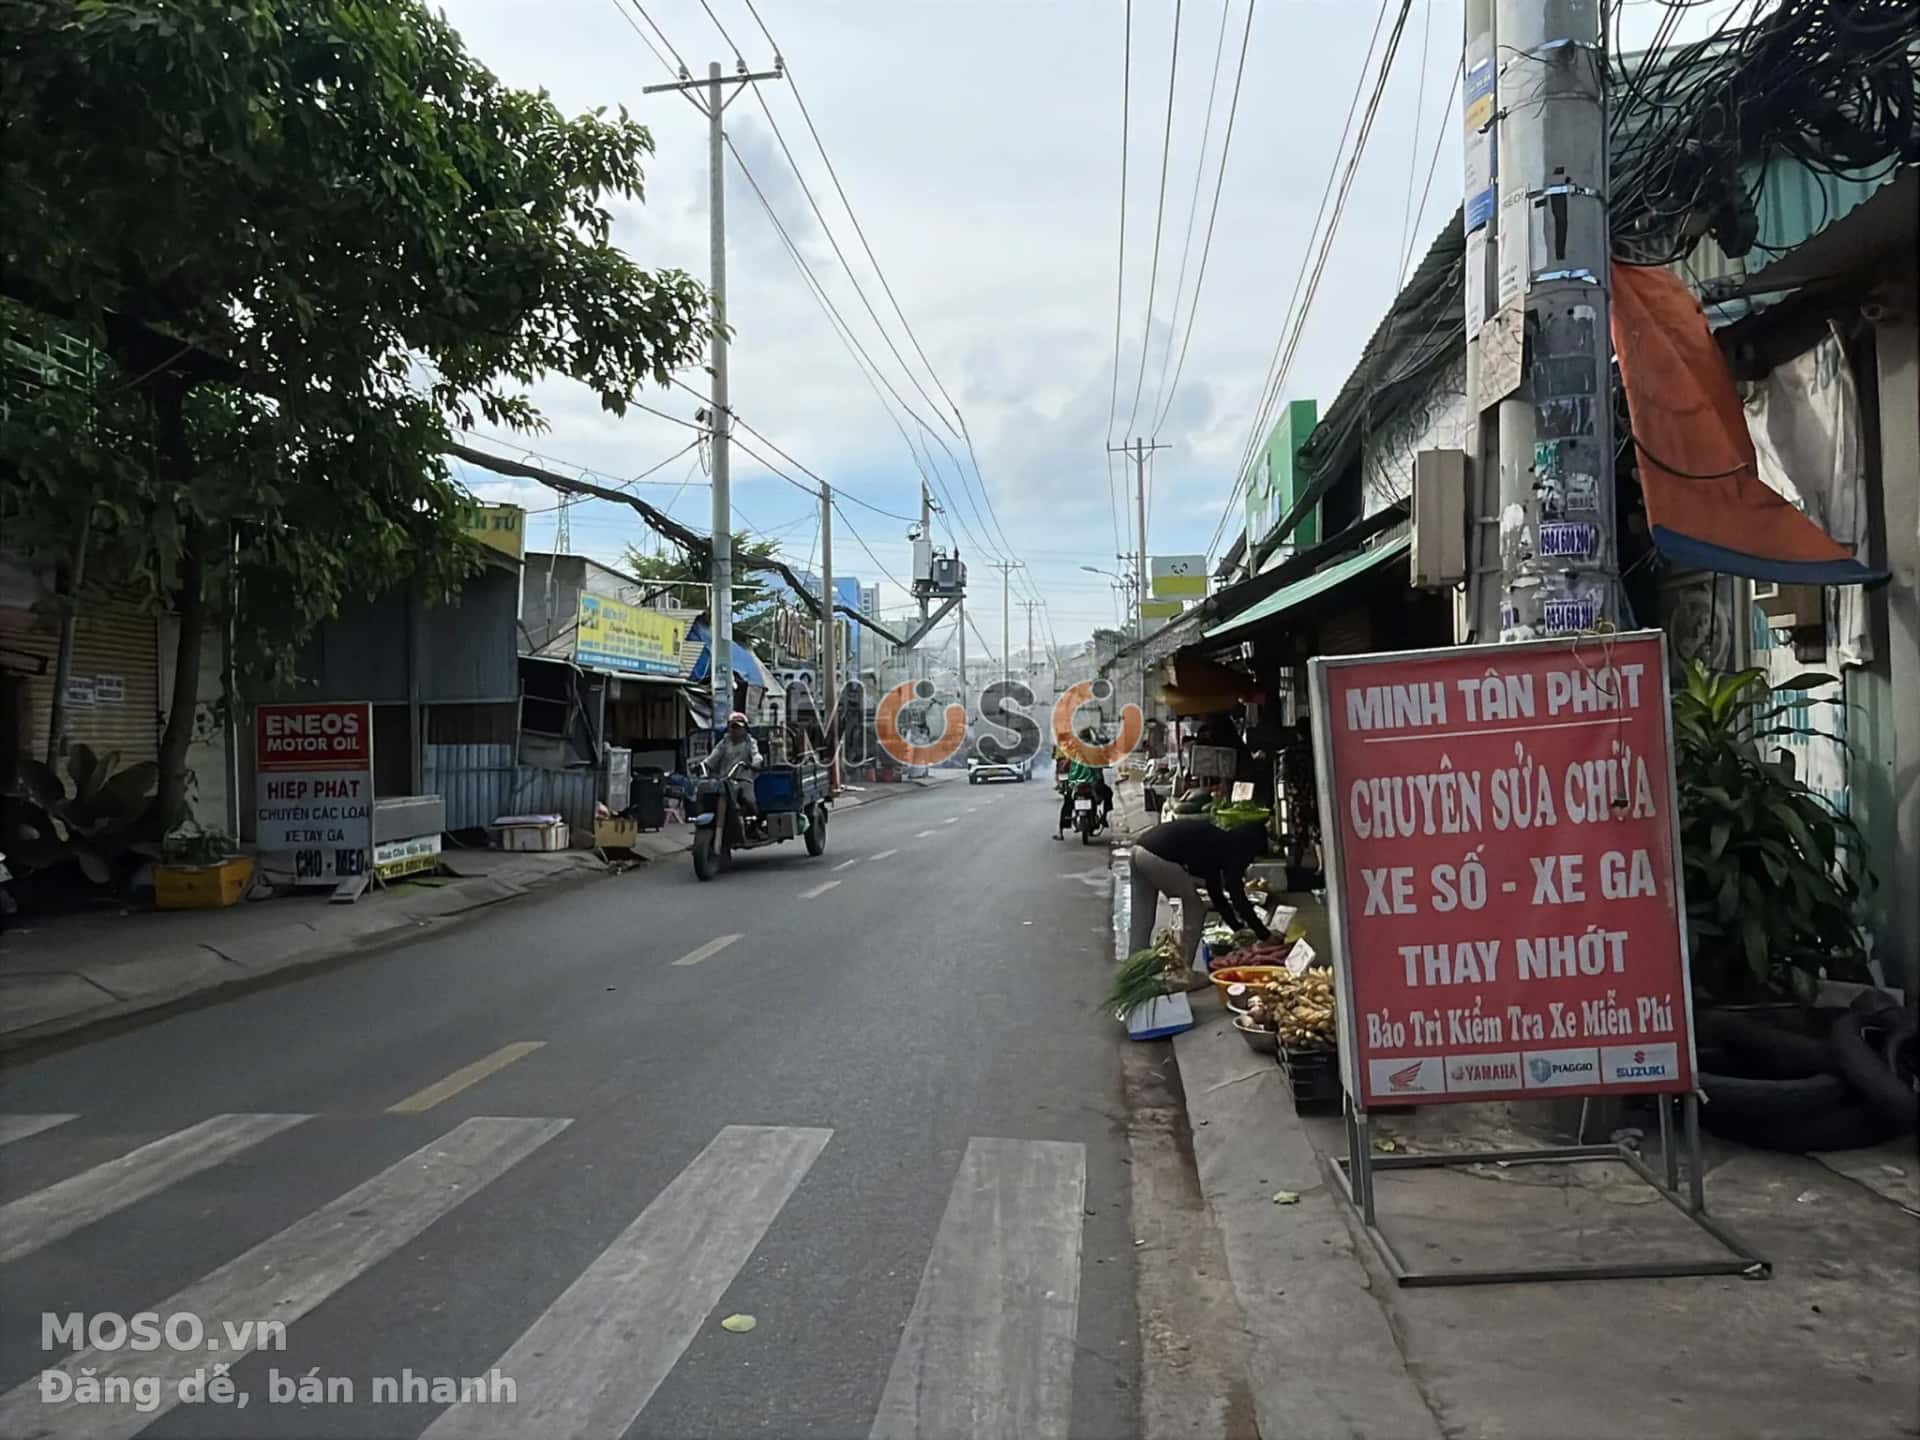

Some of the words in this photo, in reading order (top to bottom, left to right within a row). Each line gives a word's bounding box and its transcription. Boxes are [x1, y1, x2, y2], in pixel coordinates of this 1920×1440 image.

[1345, 681, 1447, 730] MINH
[1457, 667, 1536, 722] TÂN
[265, 713, 359, 736] ENEOS
[266, 737, 328, 752] MOTOR
[333, 736, 360, 751] OIL
[1350, 753, 1483, 839] CHUYÊN
[1491, 741, 1557, 831] SỬA
[1564, 739, 1656, 825] CHỮA
[327, 829, 345, 842] GA
[1360, 867, 1417, 916] XE
[1431, 844, 1487, 912] SỐ
[1502, 880, 1516, 892] -
[1529, 855, 1586, 905] XE
[1599, 849, 1656, 900] GA
[1399, 940, 1500, 987] THAY
[1515, 924, 1628, 980] NHỚT
[1366, 1008, 1405, 1049] Bảo
[1410, 1009, 1444, 1046] Trì
[1448, 996, 1502, 1044] Kiểm
[1507, 1006, 1544, 1040] Tra
[1549, 1002, 1577, 1039] Xe
[1581, 989, 1632, 1036] Miễn
[1637, 993, 1674, 1033] Phí
[1465, 1064, 1518, 1082] YAMAHA
[1552, 1062, 1594, 1075] PIAGGIO
[1615, 1065, 1666, 1078] SUZUKI
